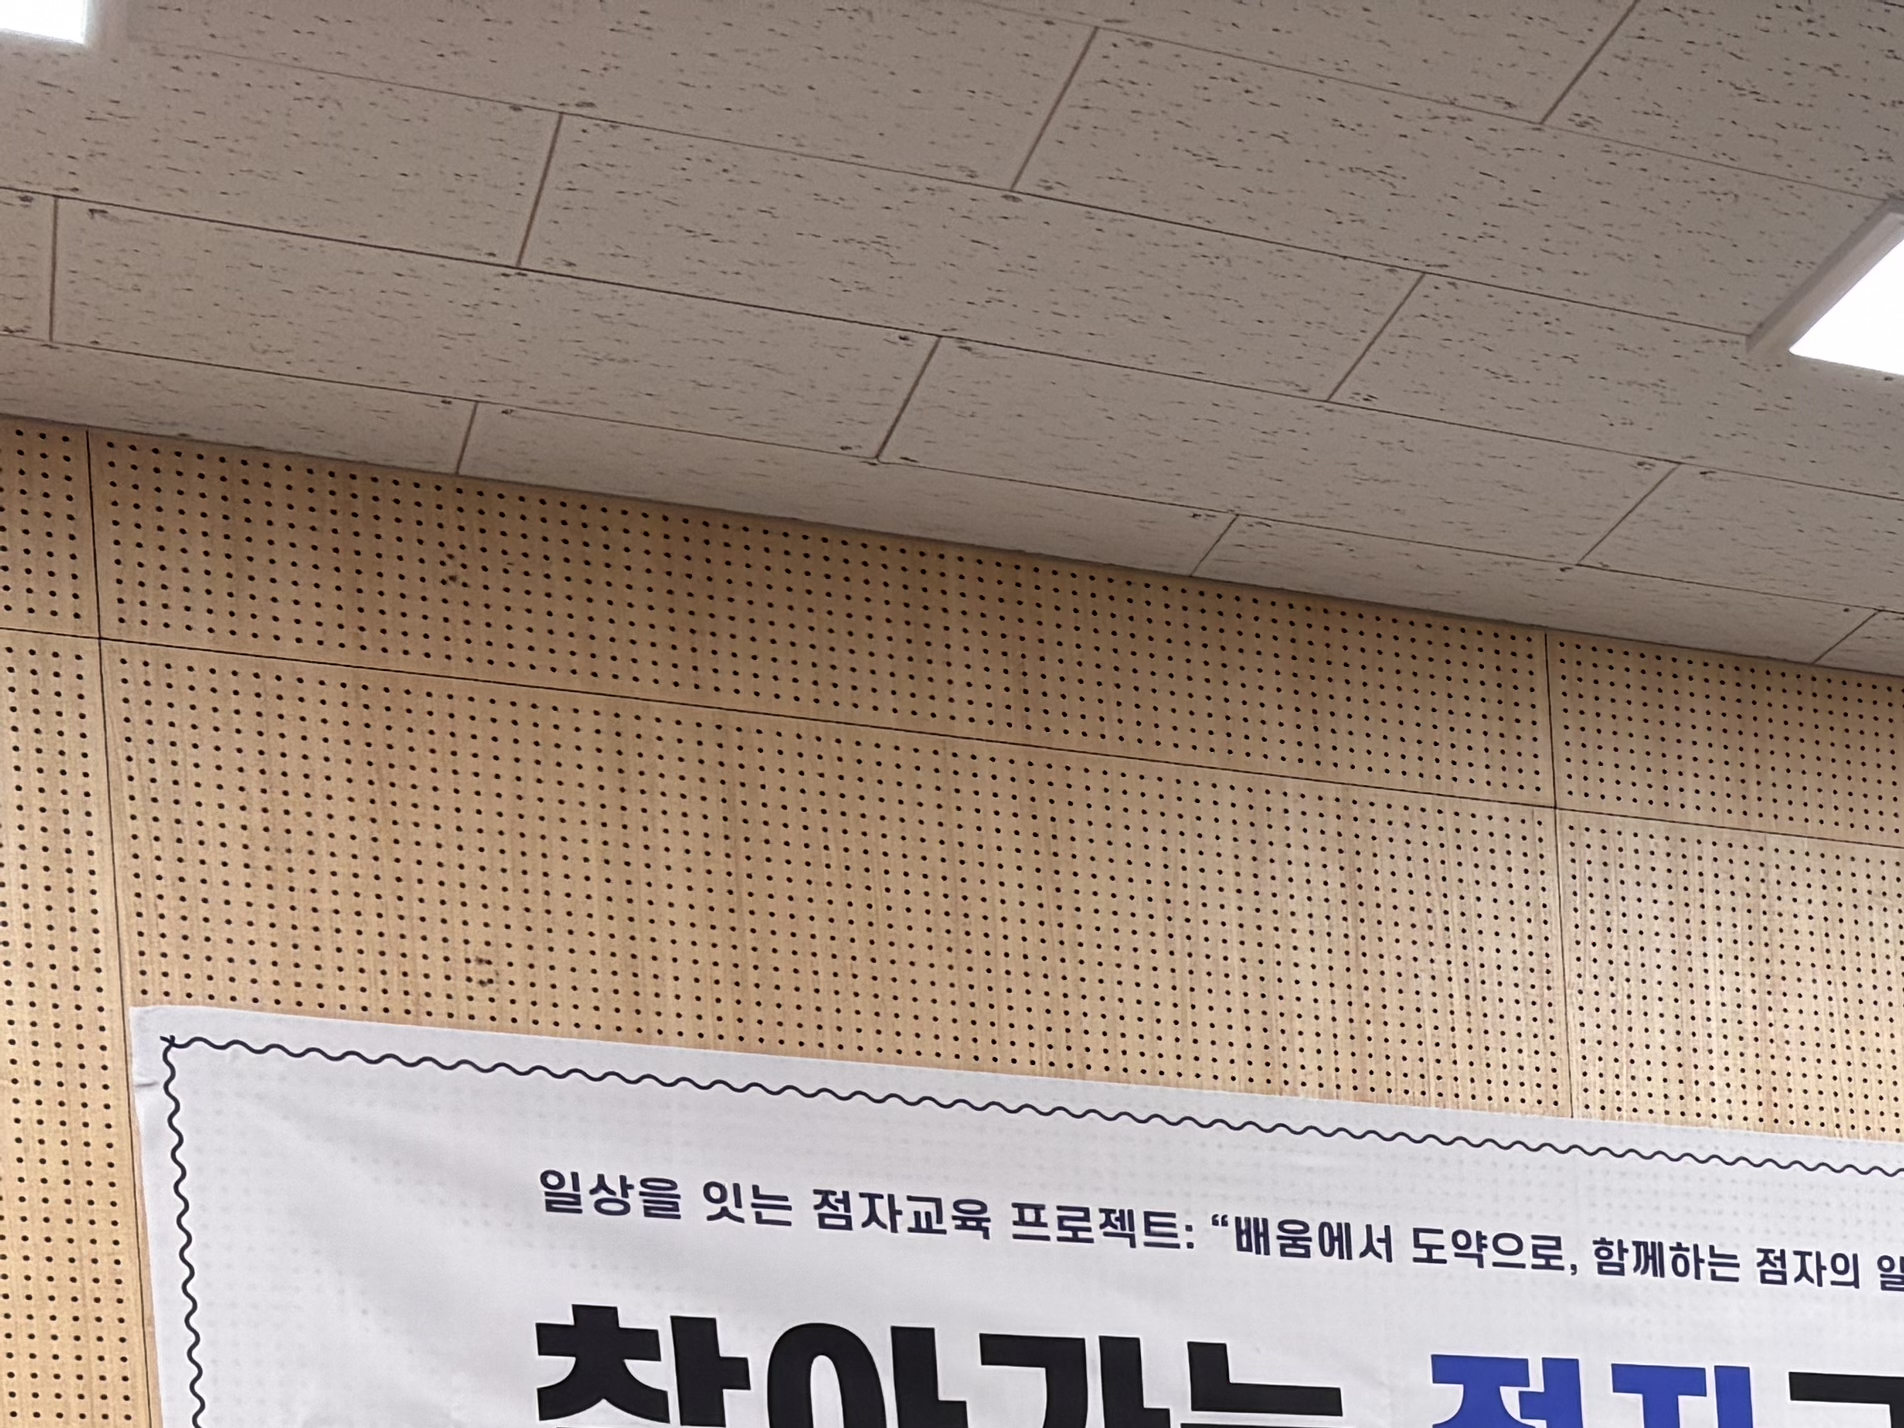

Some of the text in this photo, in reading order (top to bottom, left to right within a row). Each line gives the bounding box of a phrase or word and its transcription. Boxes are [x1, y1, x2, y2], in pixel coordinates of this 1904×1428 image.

[539, 1169, 682, 1220] 일상을
[702, 1180, 793, 1227] 잇는
[812, 1188, 992, 1241] 점자교육
[1010, 1202, 1195, 1250] 프로젝트:
[1412, 1227, 1578, 1276] 도약으로,
[1592, 1236, 1741, 1283] 함께하는
[1756, 1247, 1860, 1290] 점자의
